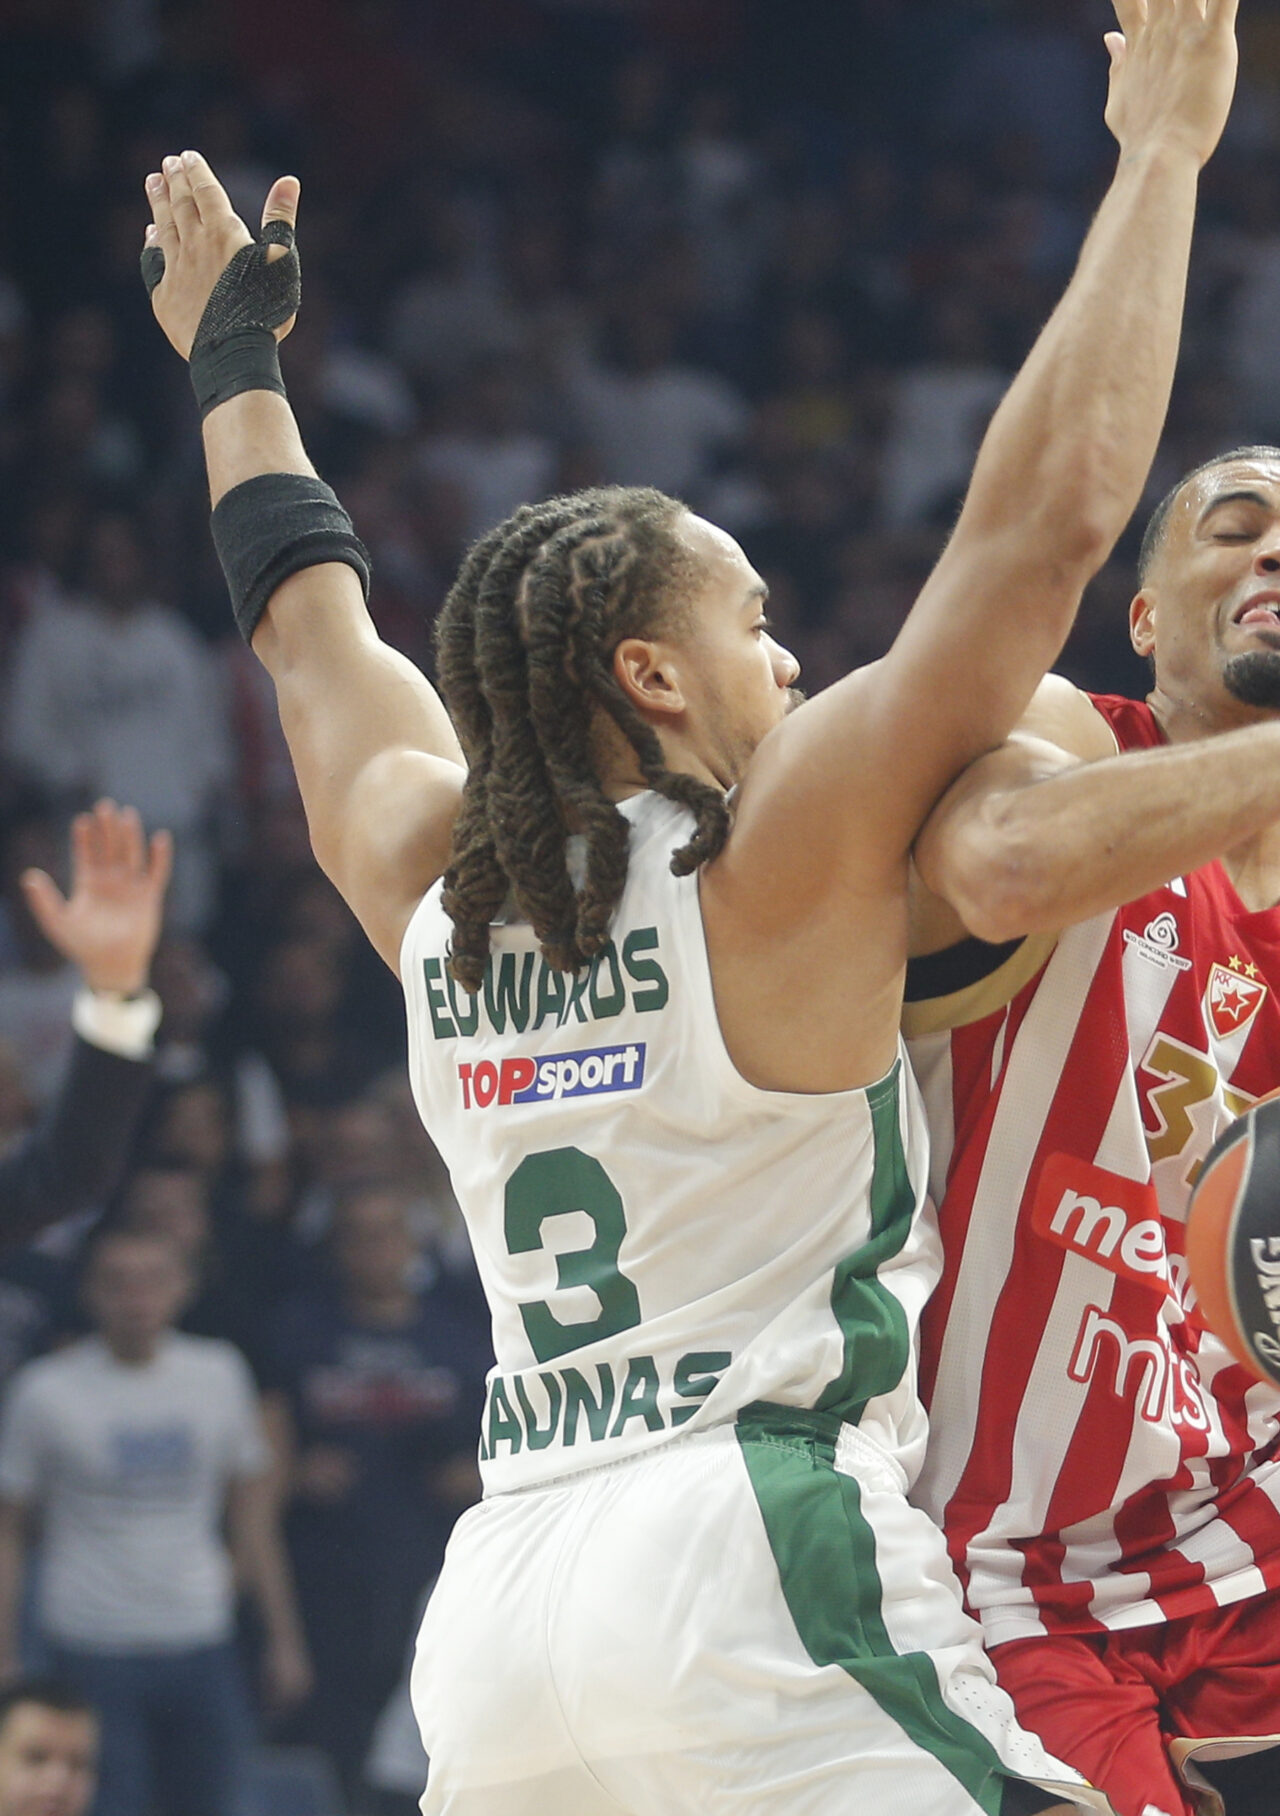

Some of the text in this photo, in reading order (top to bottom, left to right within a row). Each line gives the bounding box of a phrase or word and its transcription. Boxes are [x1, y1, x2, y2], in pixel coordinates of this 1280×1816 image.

[423, 927, 669, 1039] EDWARDS
[1145, 1034, 1255, 1186] 3
[503, 1145, 642, 1365] 3
[480, 1351, 732, 1461] AUNAS
